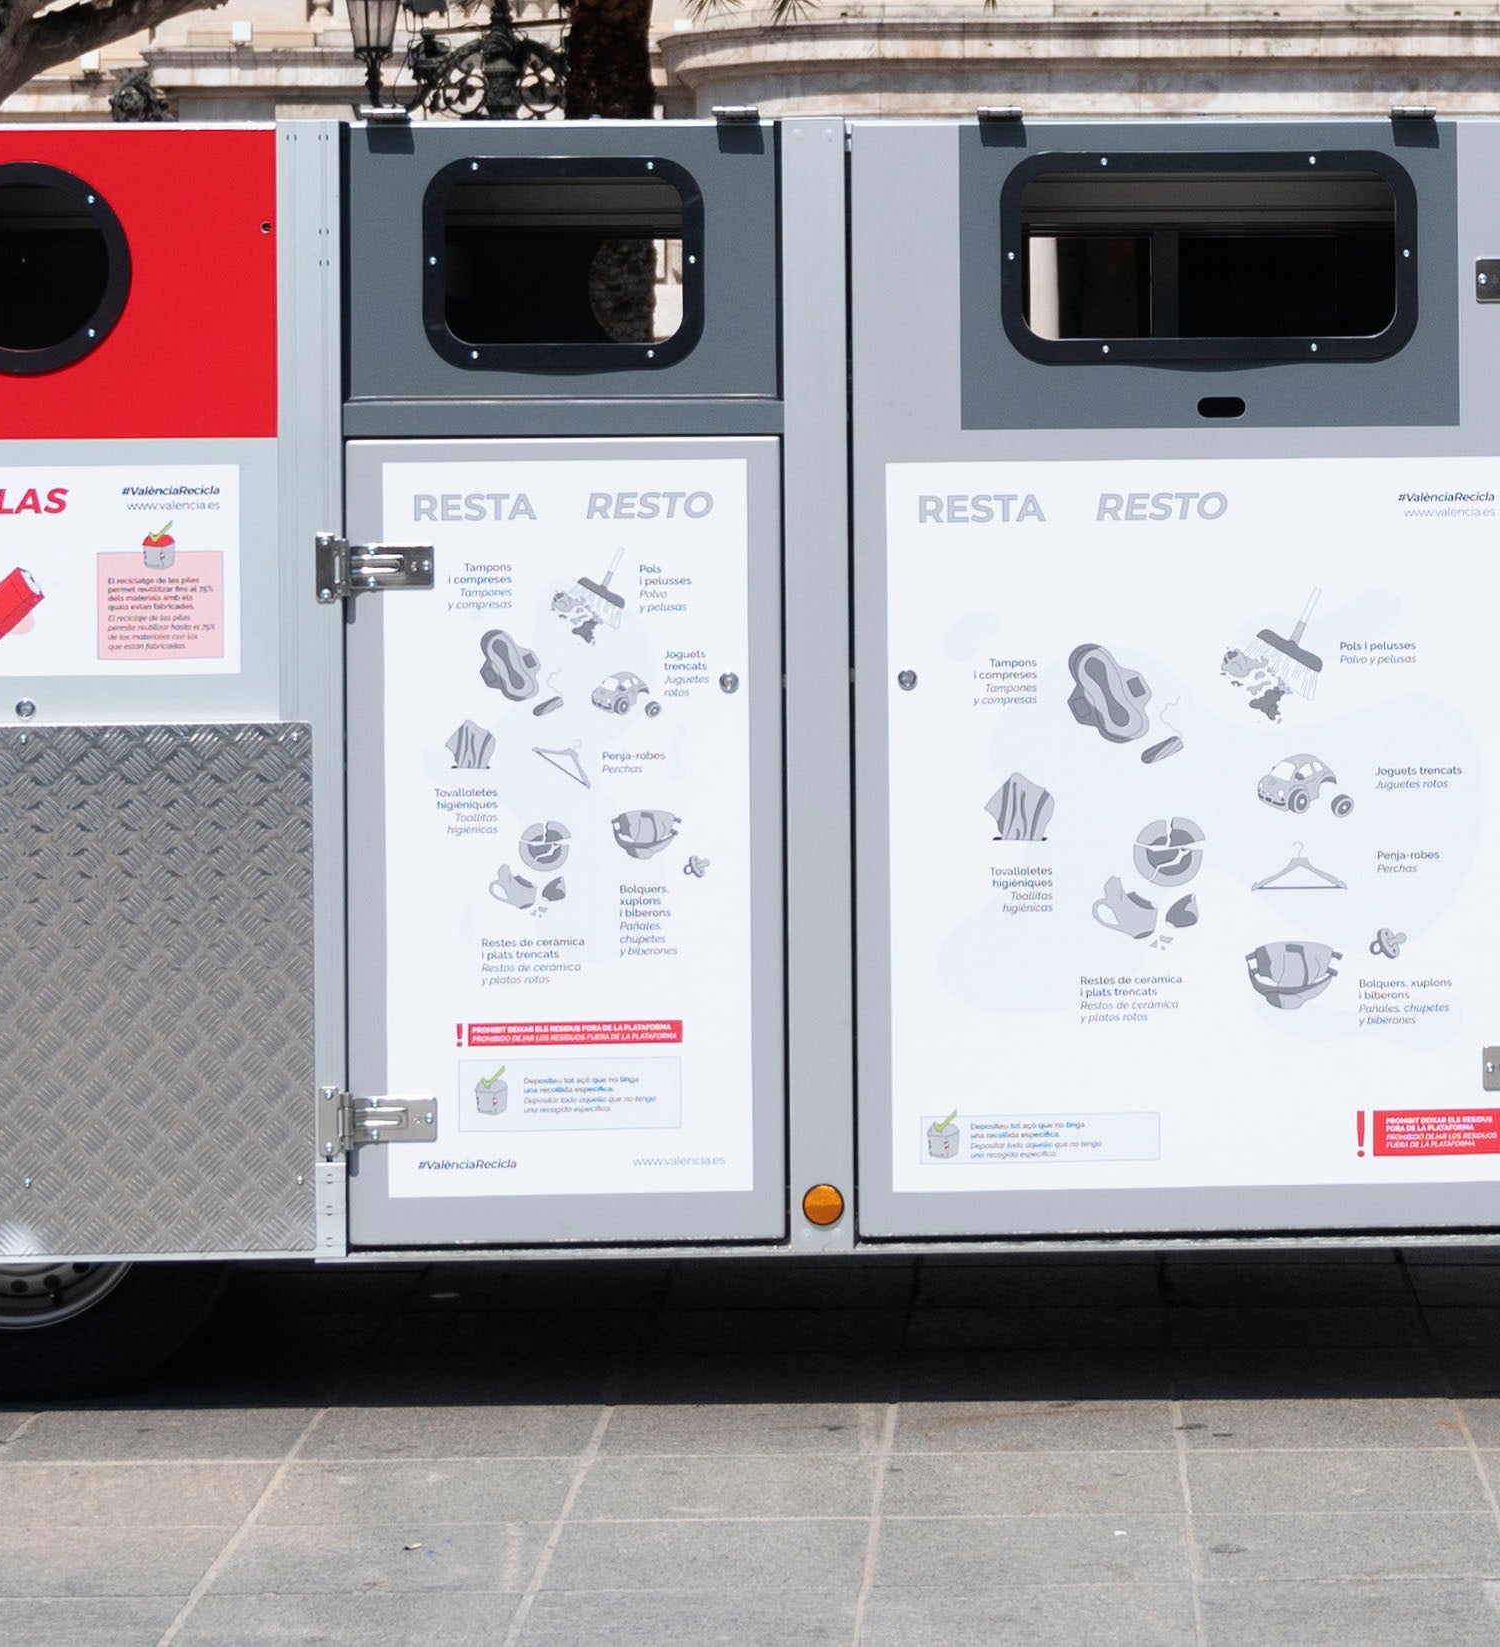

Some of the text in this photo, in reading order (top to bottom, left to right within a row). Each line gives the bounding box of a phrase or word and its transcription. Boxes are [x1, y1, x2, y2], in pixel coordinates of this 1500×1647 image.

[122, 485, 220, 495] #ValènciaRecicla
[1398, 492, 1494, 502] #ValènciaRecicla
[127, 501, 220, 510] www.valencia.es
[414, 493, 538, 521] RESTA
[586, 491, 713, 519] RESTO
[919, 494, 1046, 523] RESTA
[1097, 492, 1227, 520] RESTO
[1404, 507, 1495, 517] www.valencia.es
[464, 563, 512, 573] Tampons
[640, 565, 661, 573] Pols
[454, 577, 512, 585] compreses
[645, 577, 692, 587] pelusses
[461, 588, 512, 598] Tampones
[640, 589, 667, 598] Polvo
[456, 601, 512, 611] compresas
[647, 603, 687, 613] pelusas
[1340, 642, 1362, 650] Pols
[1370, 641, 1416, 651] pelusses
[663, 650, 706, 661] Joguets
[1340, 655, 1368, 664] Polvo
[1377, 655, 1416, 665] pelusas
[664, 660, 707, 670] trencats
[989, 659, 1037, 669] Tampons
[664, 675, 709, 686] Juguetes
[979, 672, 1037, 681] compreses
[986, 684, 1037, 694] Tampones
[982, 696, 1037, 706] compresas
[602, 752, 666, 762] Penja-robes
[602, 765, 643, 773] Perchas
[1376, 766, 1462, 777] Joguets trencats
[1376, 780, 1448, 790] Juguetes rotos
[434, 788, 498, 797] Tovalloletes
[456, 813, 498, 822] Toallitas
[1378, 851, 1439, 861] Penja-robes
[990, 867, 1052, 875] Tovalloletes
[1377, 864, 1417, 872] Perchas
[993, 879, 1052, 890] higièniques
[1011, 891, 1052, 900] Toallitas
[620, 897, 661, 908] xuplons
[625, 907, 671, 917] biberons
[1003, 903, 1053, 915] higiénicas
[620, 935, 666, 945] chupetes
[628, 946, 677, 955] biberones
[1081, 976, 1182, 985] Restes de ceràmica
[1086, 988, 1112, 998] plats
[1114, 987, 1157, 996] trencats
[1364, 989, 1409, 1000] biberons
[1080, 1000, 1179, 1010] Restos de cerámica
[1088, 1013, 1120, 1024] platos
[1123, 1013, 1148, 1021] rotos
[1367, 1016, 1415, 1024] biberones
[418, 1159, 517, 1170] #ValènciaRecicla
[632, 1156, 725, 1166] www.valencia.es
